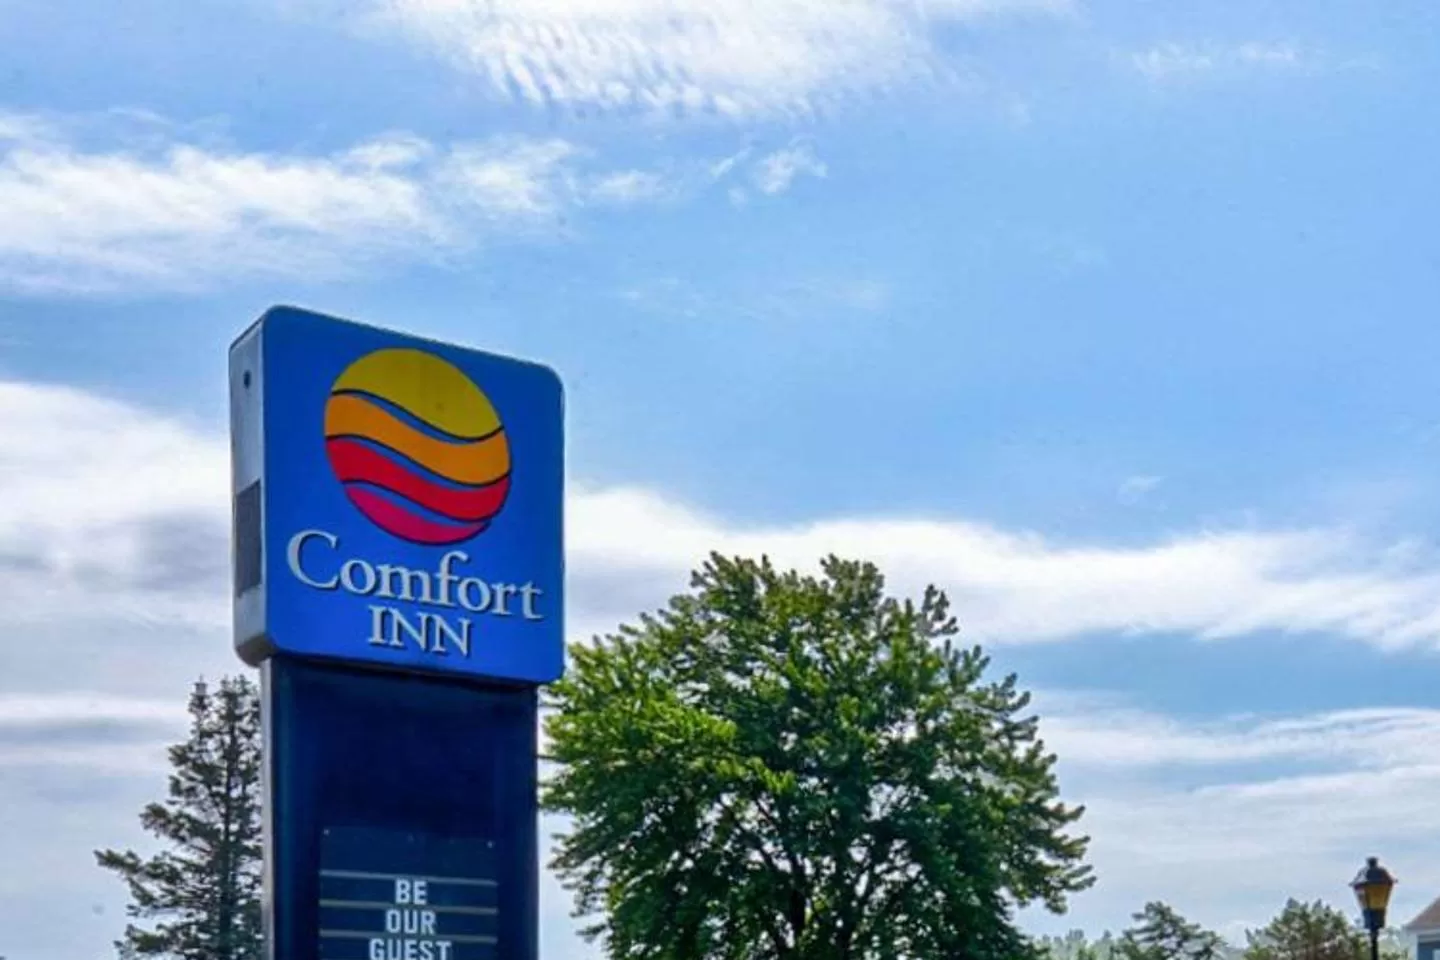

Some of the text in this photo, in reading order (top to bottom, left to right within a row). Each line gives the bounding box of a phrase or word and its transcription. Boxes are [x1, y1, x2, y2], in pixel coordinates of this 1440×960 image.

[286, 529, 544, 619] Comfort
[368, 605, 471, 656] INN
[395, 879, 427, 906] BE
[385, 909, 436, 935] OUR
